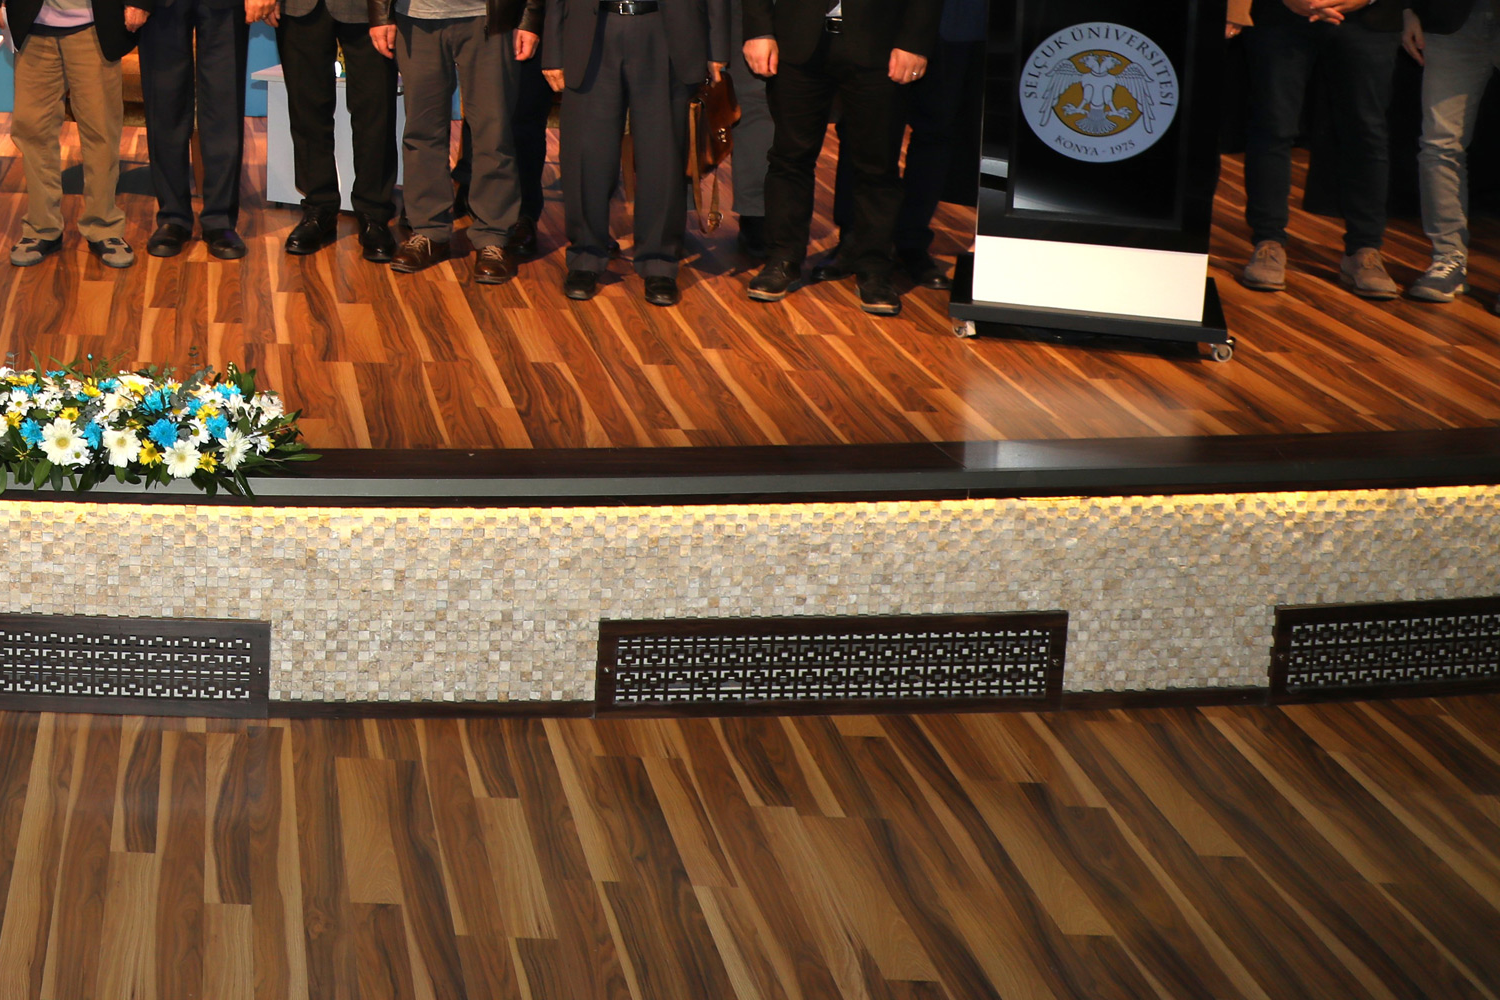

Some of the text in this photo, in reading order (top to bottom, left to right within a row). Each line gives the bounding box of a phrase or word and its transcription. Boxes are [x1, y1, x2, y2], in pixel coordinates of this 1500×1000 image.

[1024, 35, 1069, 99] SELÇUK
[1054, 134, 1100, 157] KONYA
[1109, 139, 1137, 156] 1975
